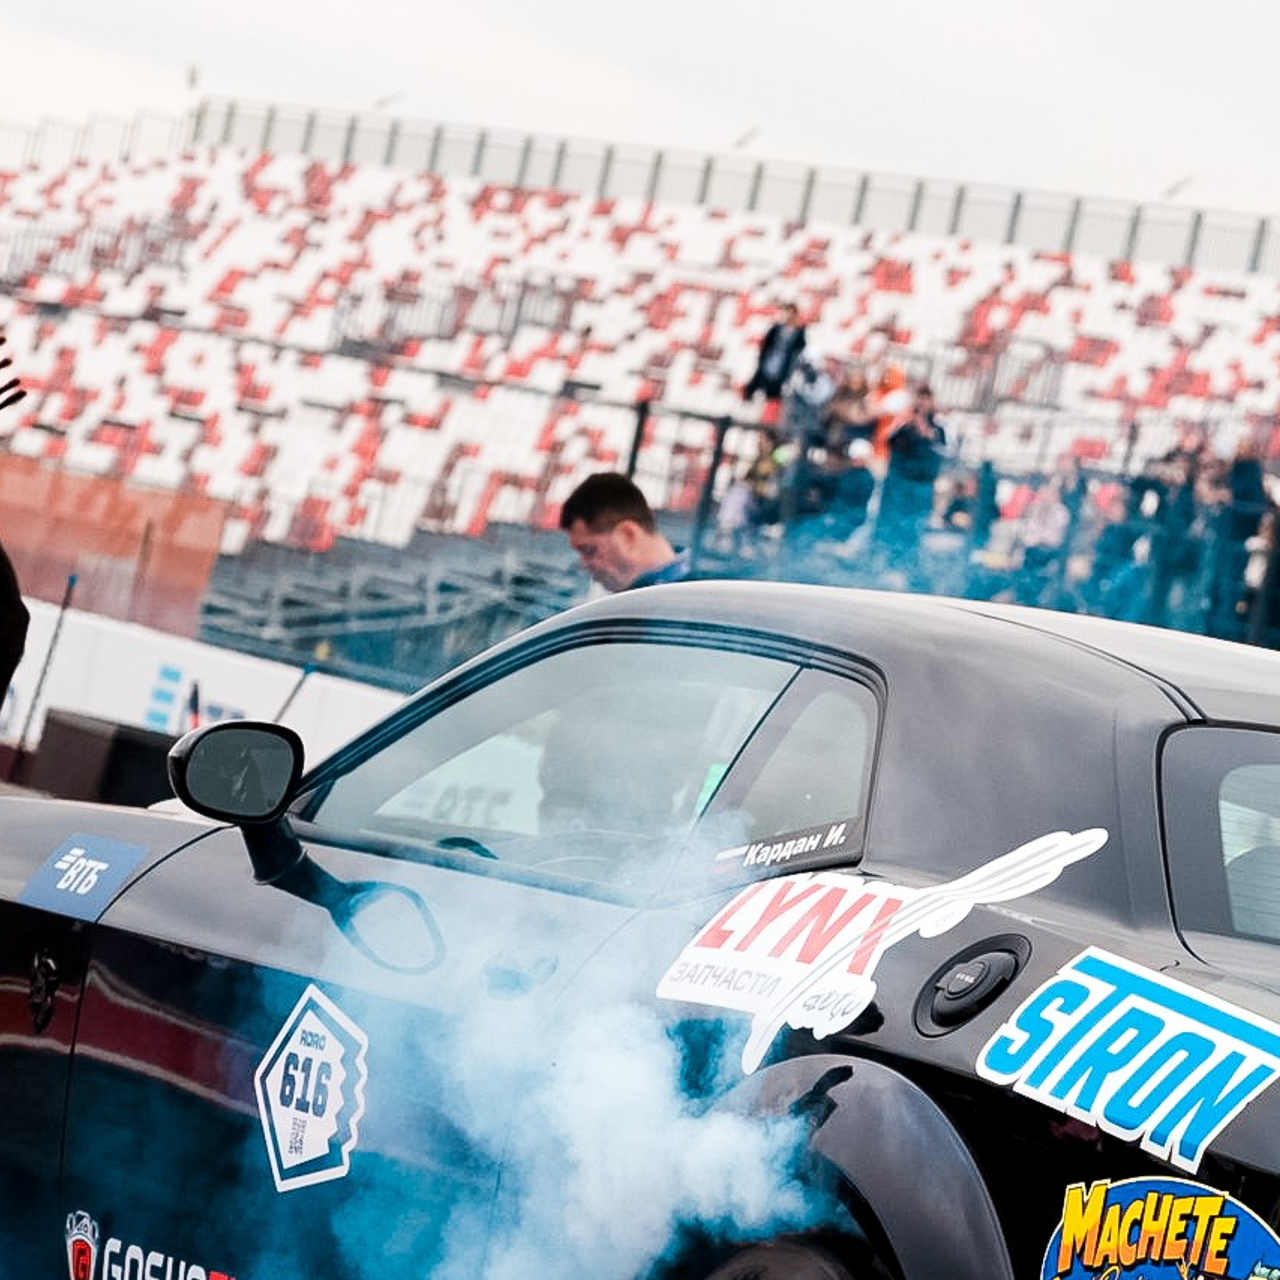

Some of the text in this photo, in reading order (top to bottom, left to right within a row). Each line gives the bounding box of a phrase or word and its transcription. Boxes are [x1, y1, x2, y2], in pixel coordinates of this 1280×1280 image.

[742, 822, 847, 867] Кардан И.
[55, 857, 110, 895] ВТБ
[668, 960, 782, 998] ЗАПЧАСТИ
[279, 1051, 333, 1119] 616
